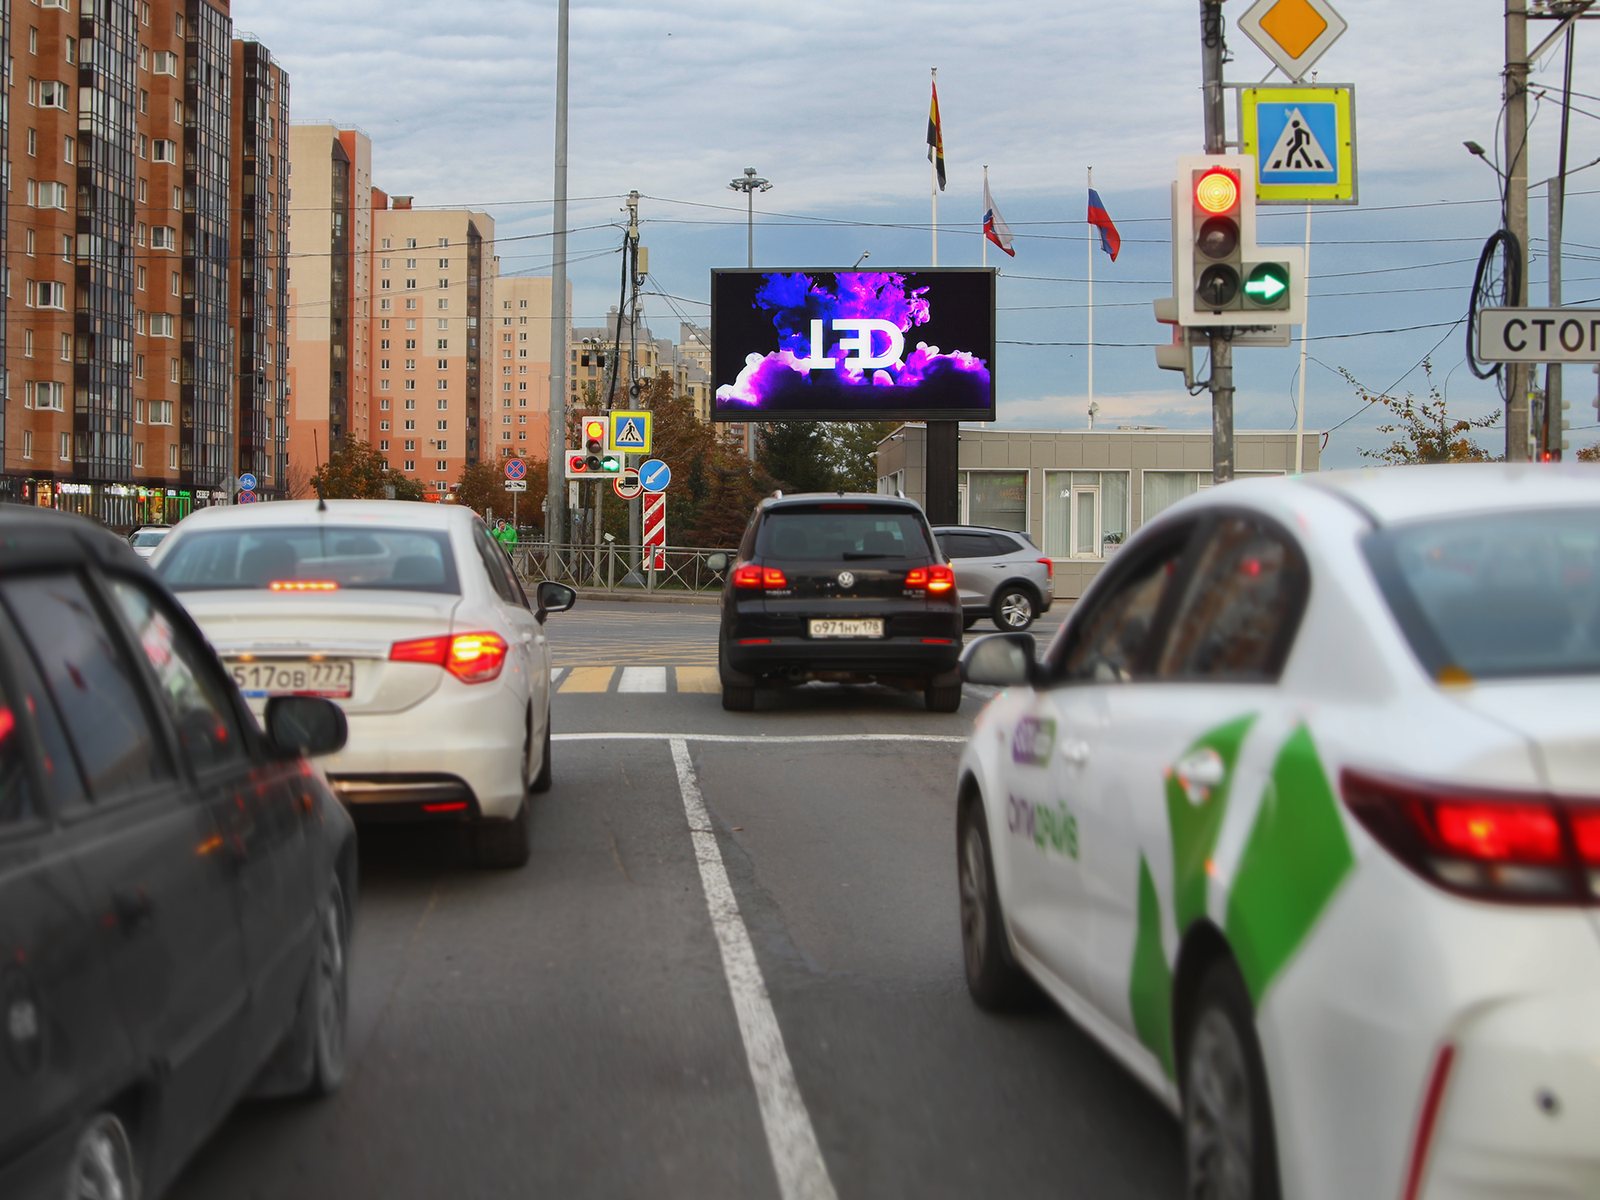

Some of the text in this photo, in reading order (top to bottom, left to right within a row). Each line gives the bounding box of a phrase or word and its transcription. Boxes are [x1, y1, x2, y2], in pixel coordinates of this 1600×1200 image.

[810, 319, 904, 369] LED
[862, 620, 880, 631] 178
[229, 664, 345, 688] 517ОВ 777
